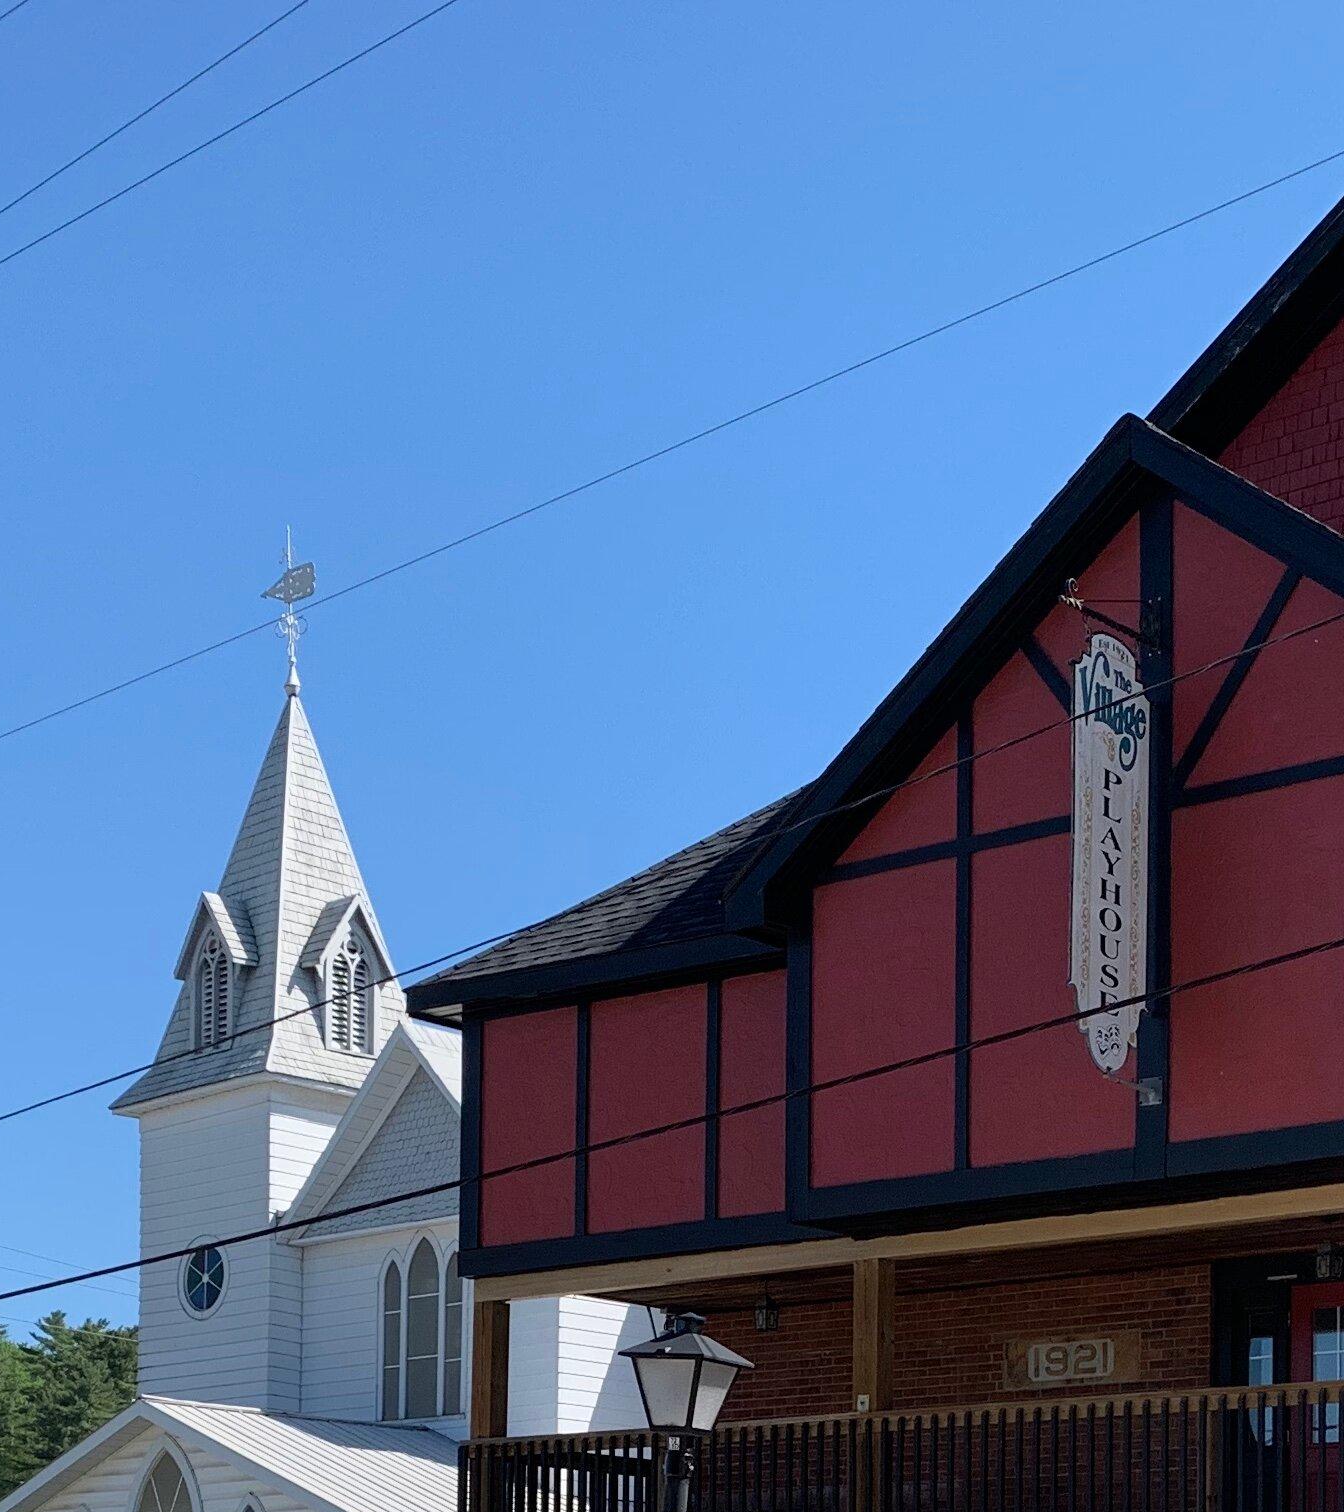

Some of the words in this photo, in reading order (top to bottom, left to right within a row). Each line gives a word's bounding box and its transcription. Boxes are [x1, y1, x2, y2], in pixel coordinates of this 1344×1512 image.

[1079, 651, 1147, 771] Village
[1113, 669, 1132, 694] The
[1098, 768, 1123, 1017] PLAYHOUSE
[1033, 1342, 1109, 1378] 1921
